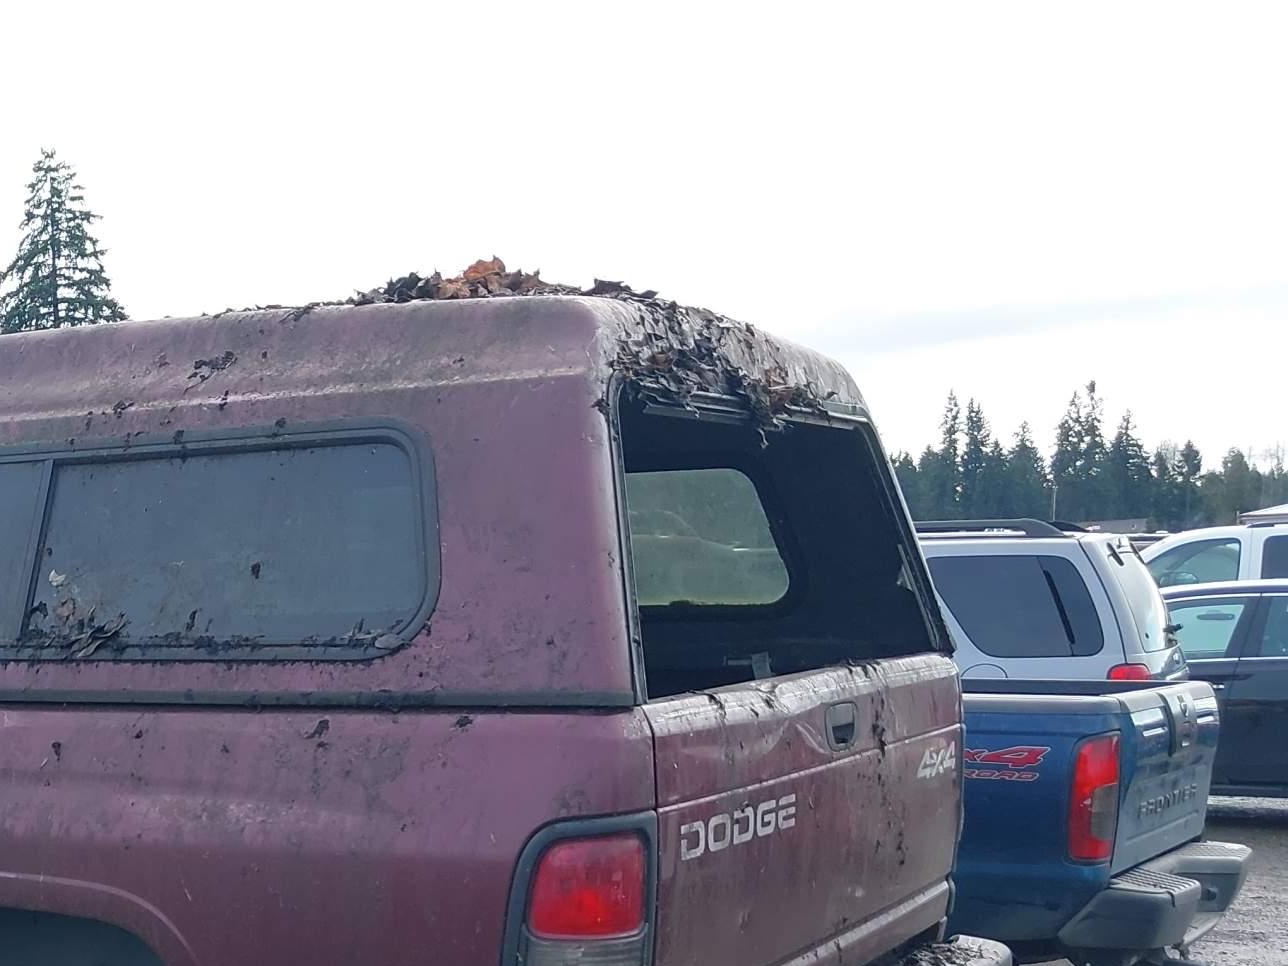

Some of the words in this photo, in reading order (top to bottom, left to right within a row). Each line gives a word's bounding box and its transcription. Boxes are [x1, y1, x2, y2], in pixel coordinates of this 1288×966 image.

[963, 745, 1051, 769] x4
[1137, 783, 1198, 818] FRONTIER
[680, 793, 796, 861] DODGE
